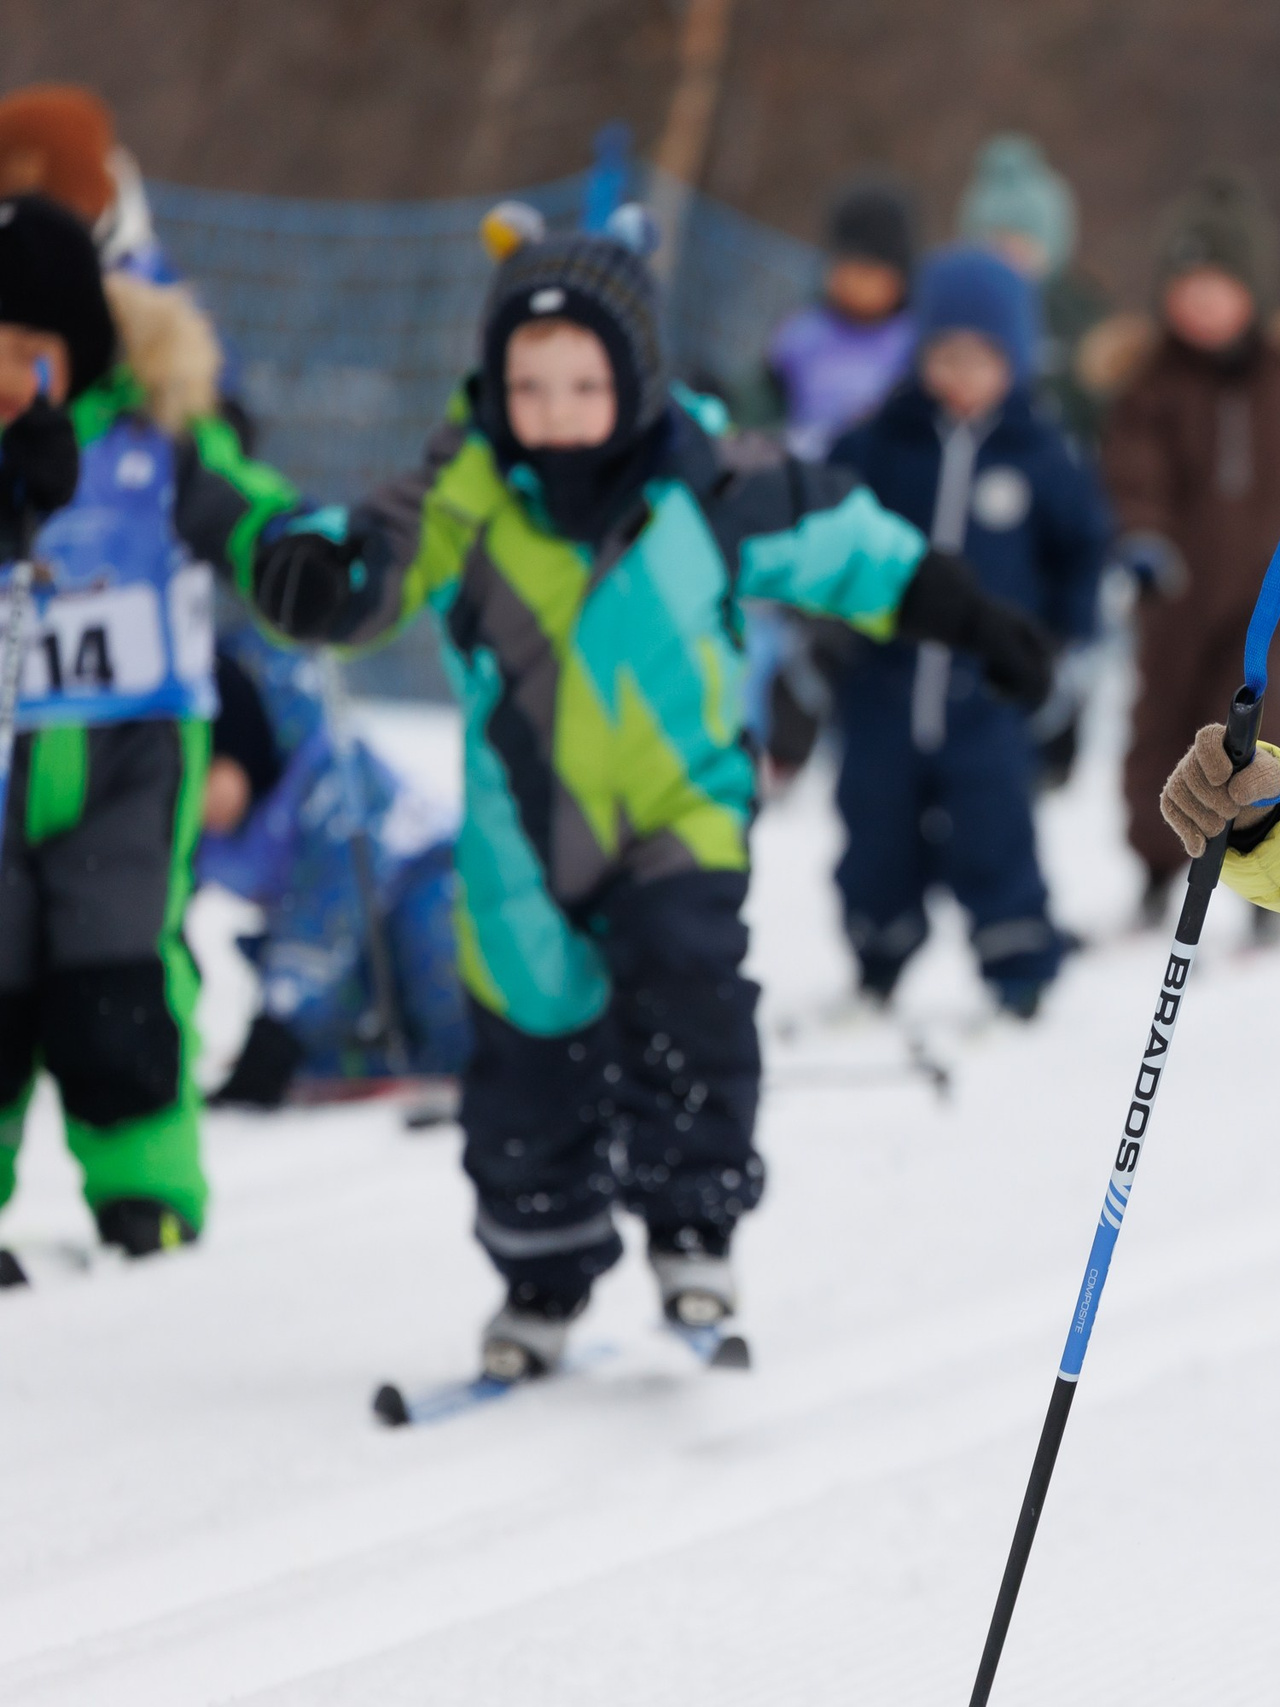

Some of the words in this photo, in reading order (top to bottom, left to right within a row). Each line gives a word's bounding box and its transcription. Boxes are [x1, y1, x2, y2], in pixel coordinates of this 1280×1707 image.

[14, 622, 114, 690] 14
[1115, 952, 1191, 1173] BRADOS
[1074, 1268, 1099, 1335] COMPOSITE
